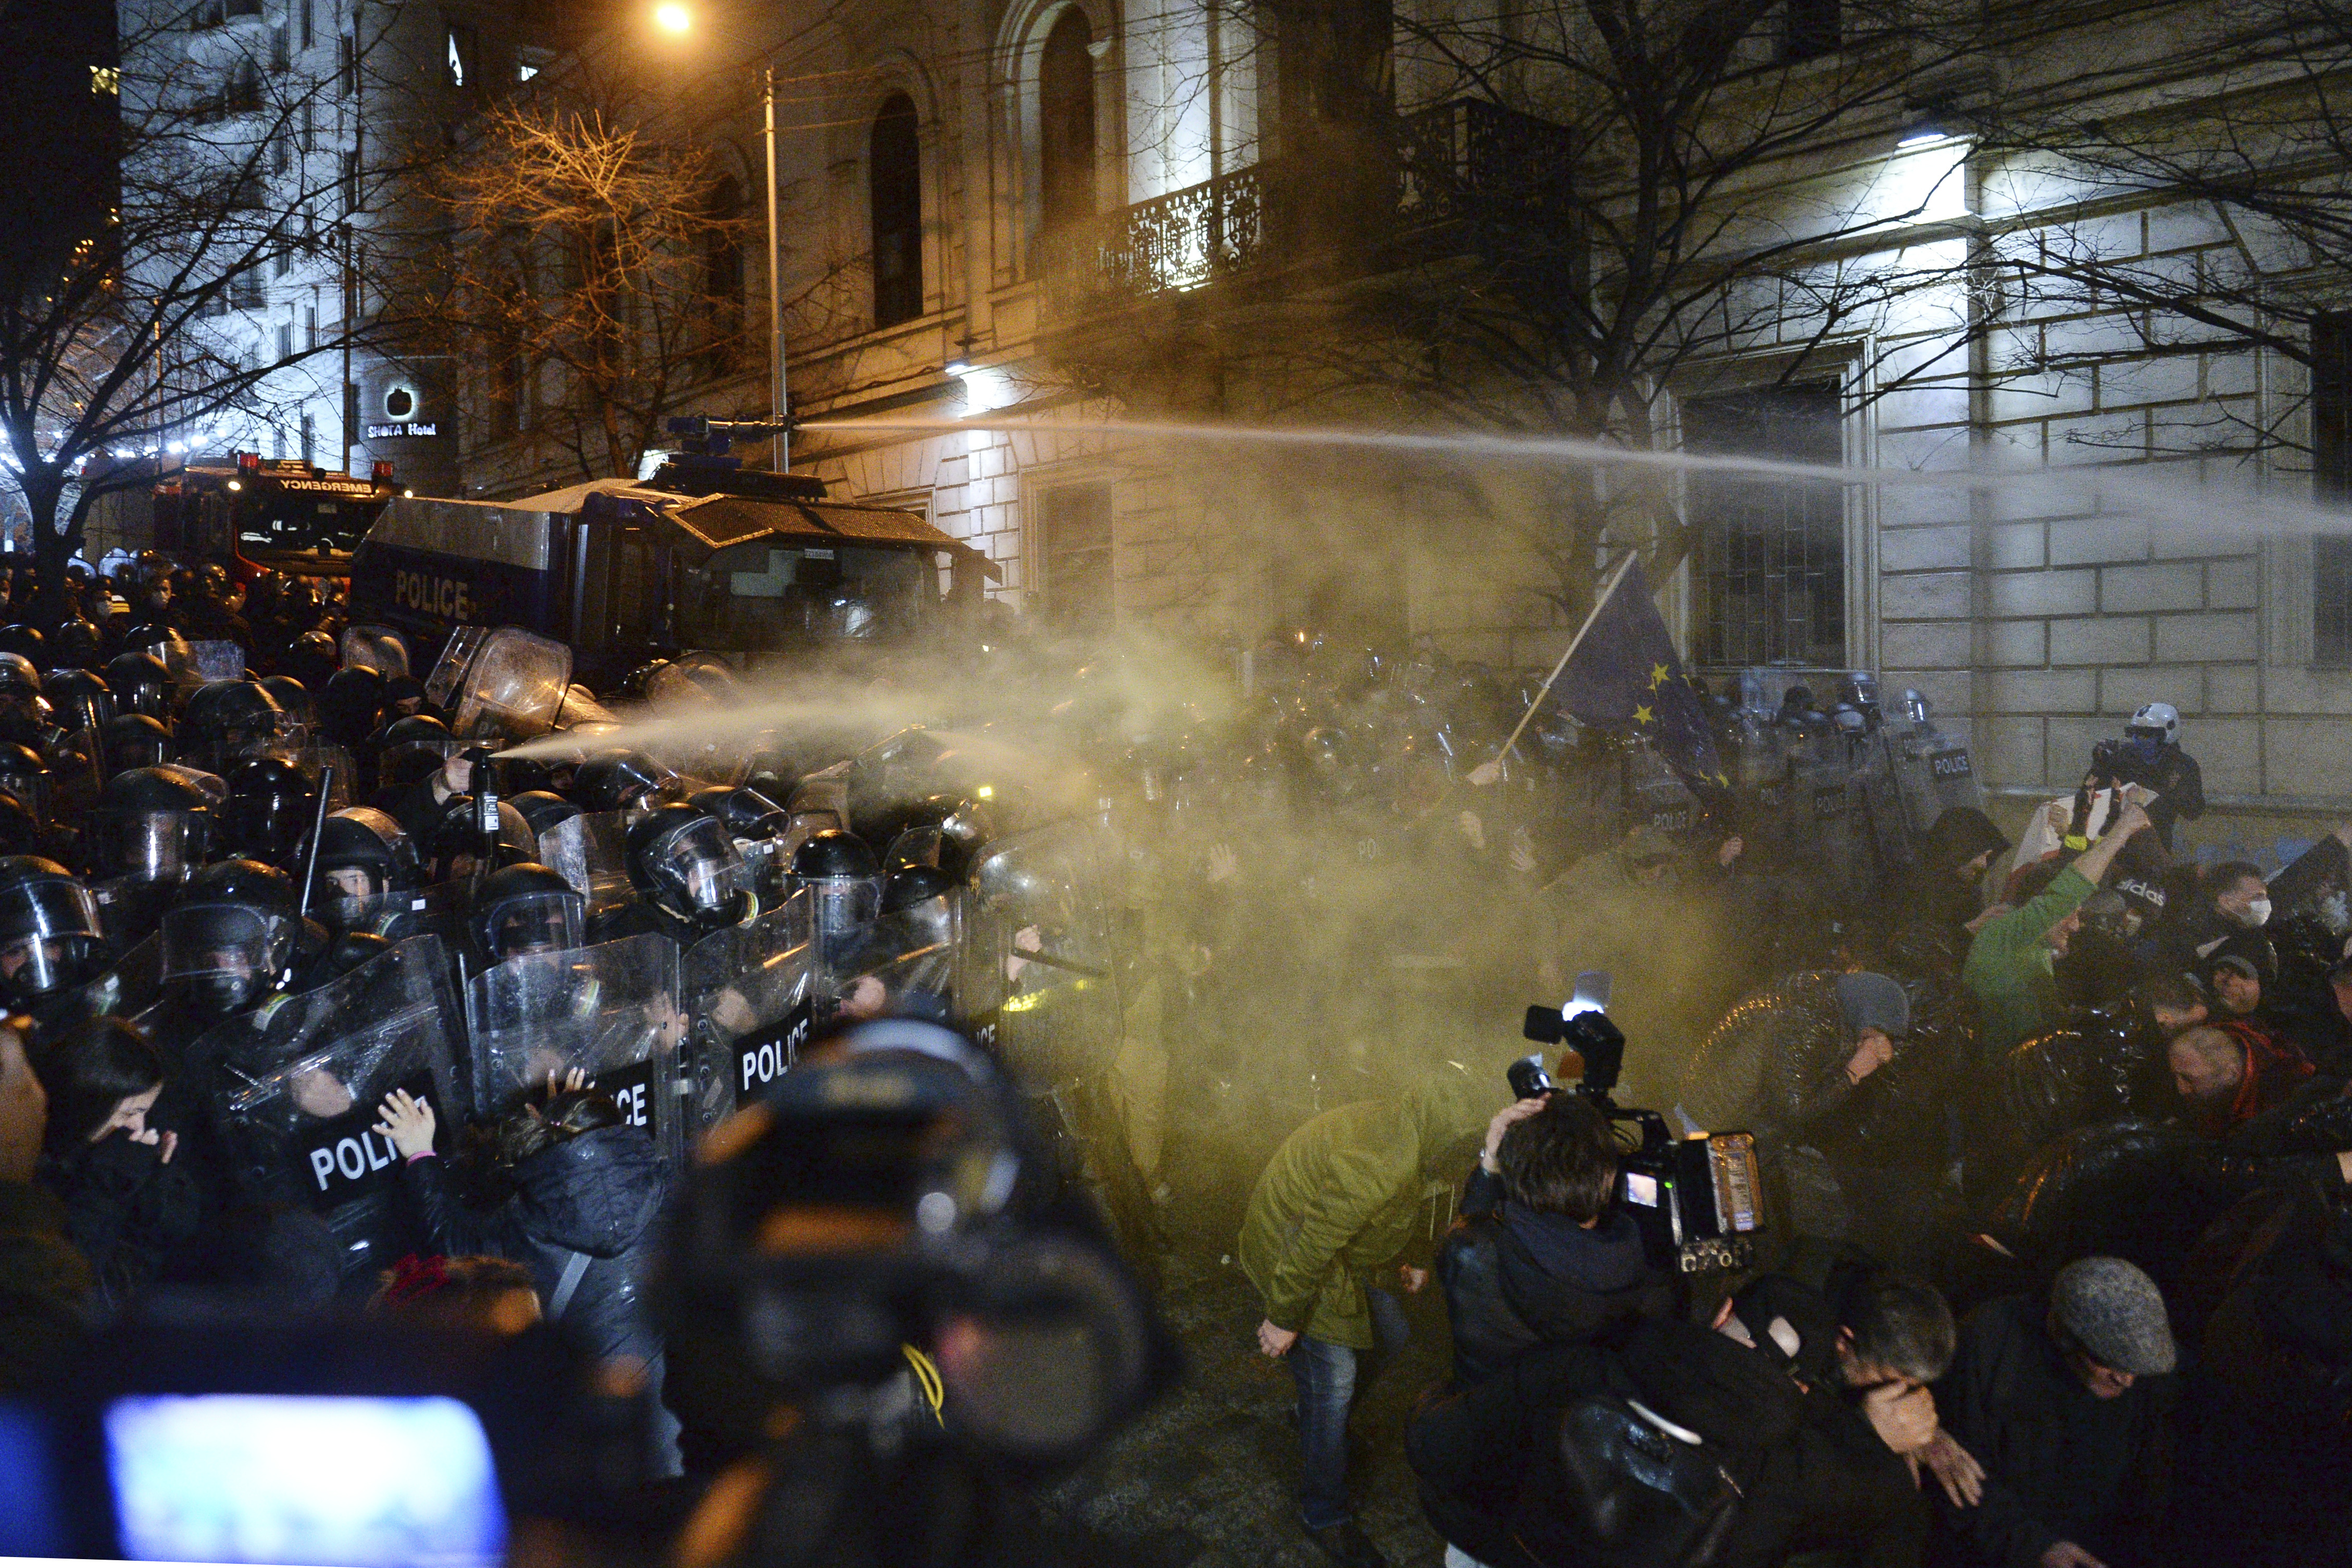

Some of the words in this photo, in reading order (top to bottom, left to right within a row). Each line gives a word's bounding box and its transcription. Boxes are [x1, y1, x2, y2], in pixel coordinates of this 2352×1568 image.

[368, 424, 403, 438] SHOTA
[408, 423, 436, 436] Hotel
[395, 570, 469, 620] POLICE
[1934, 755, 1969, 775] POLICE
[743, 1018, 807, 1091] POLICE
[310, 1095, 426, 1191] POLI
